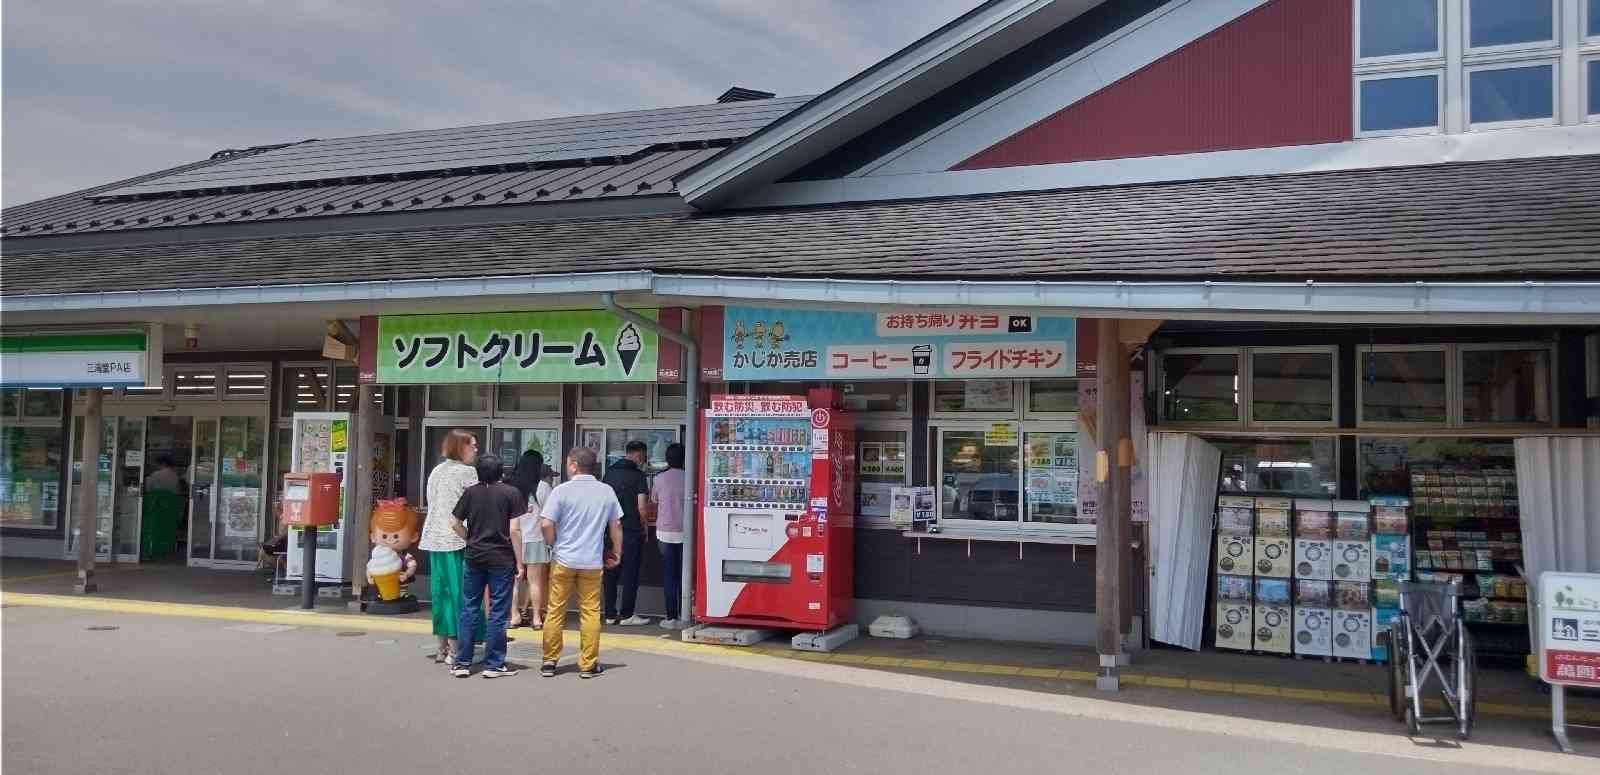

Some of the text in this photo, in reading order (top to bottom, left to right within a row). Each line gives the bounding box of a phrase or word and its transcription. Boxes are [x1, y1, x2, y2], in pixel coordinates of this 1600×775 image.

[886, 313, 956, 330] お持ち帰り
[1012, 319, 1028, 328] OK
[394, 332, 606, 370] ソフトクリーム
[733, 349, 818, 369] かじか売店
[831, 351, 910, 370] コーヒー
[951, 350, 1063, 371] フライドチキン
